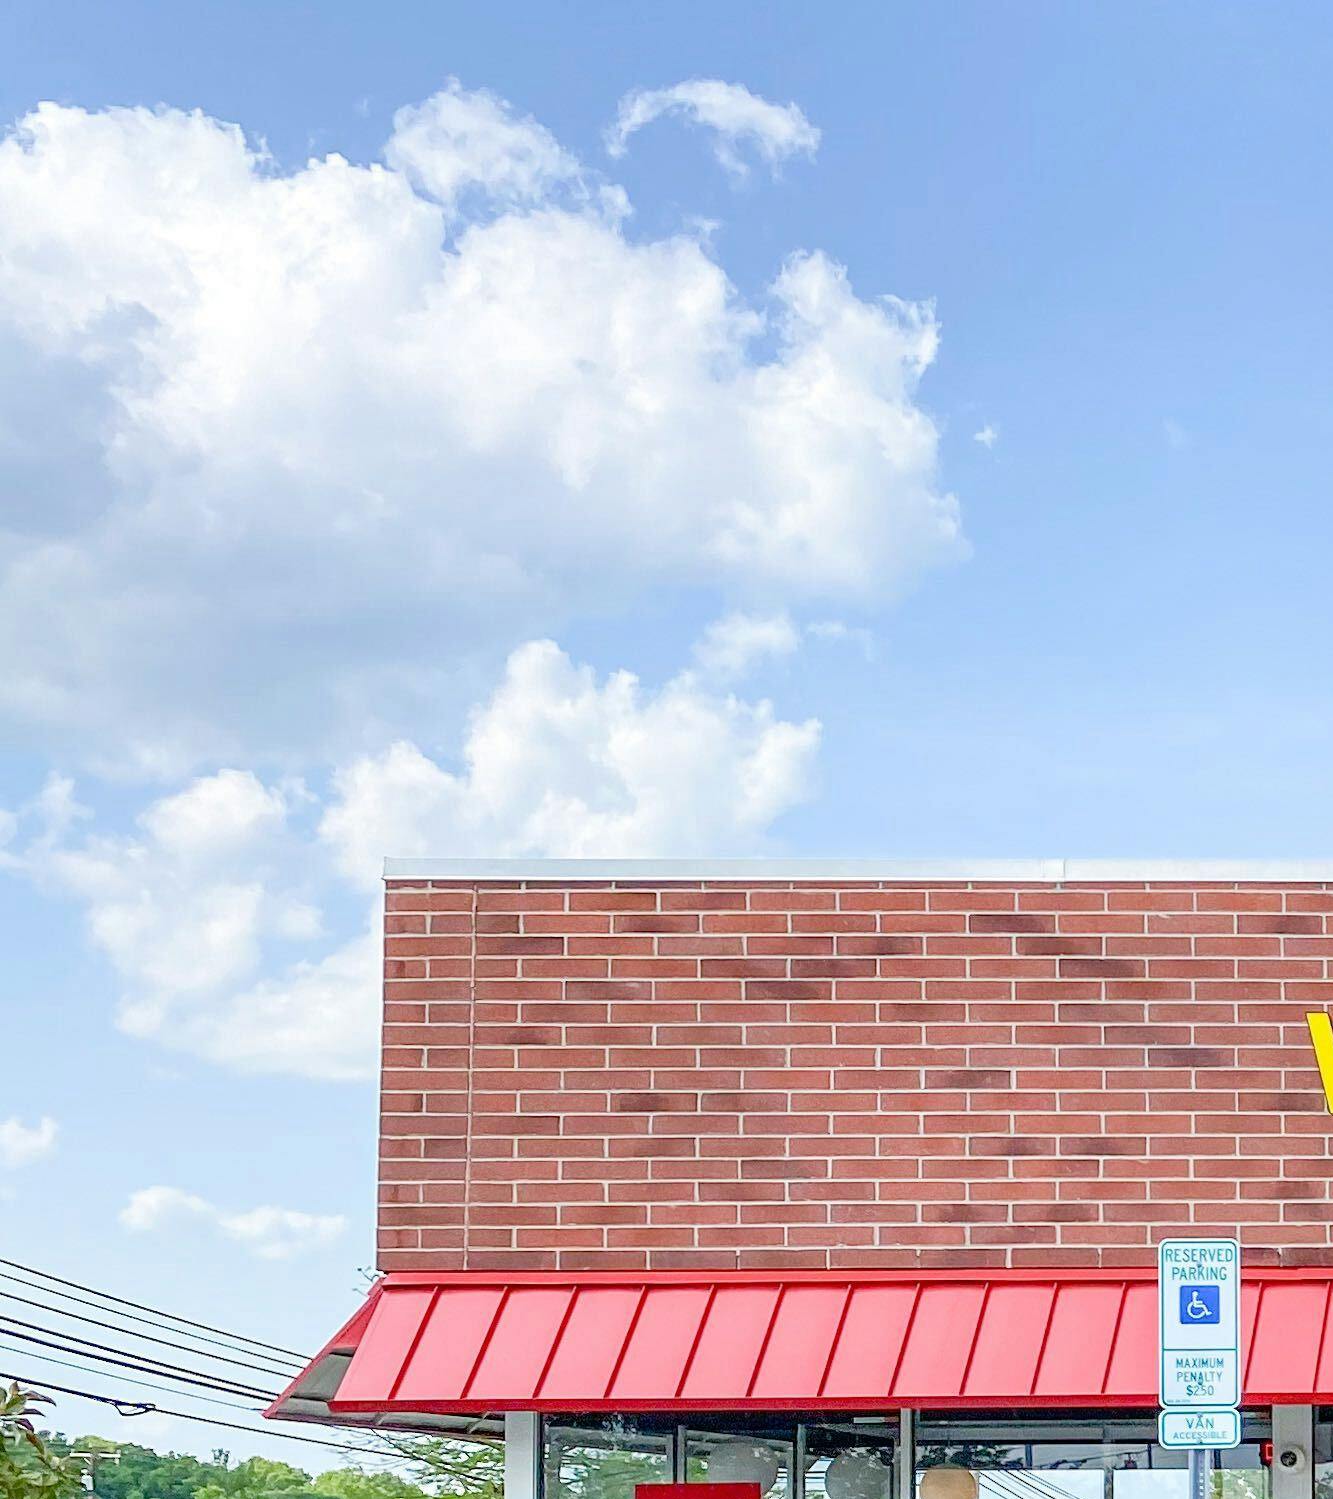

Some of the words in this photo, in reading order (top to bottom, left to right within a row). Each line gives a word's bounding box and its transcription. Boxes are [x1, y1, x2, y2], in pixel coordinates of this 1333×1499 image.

[1165, 1248, 1234, 1262] RESERVED
[1172, 1266, 1227, 1280] PARKING
[1175, 1358, 1224, 1369] MAXIMUM
[1176, 1371, 1223, 1382] PENALTY
[1186, 1384, 1215, 1396] $250
[1185, 1418, 1215, 1429] VAN
[1173, 1431, 1228, 1439] ACCESSIBLE
